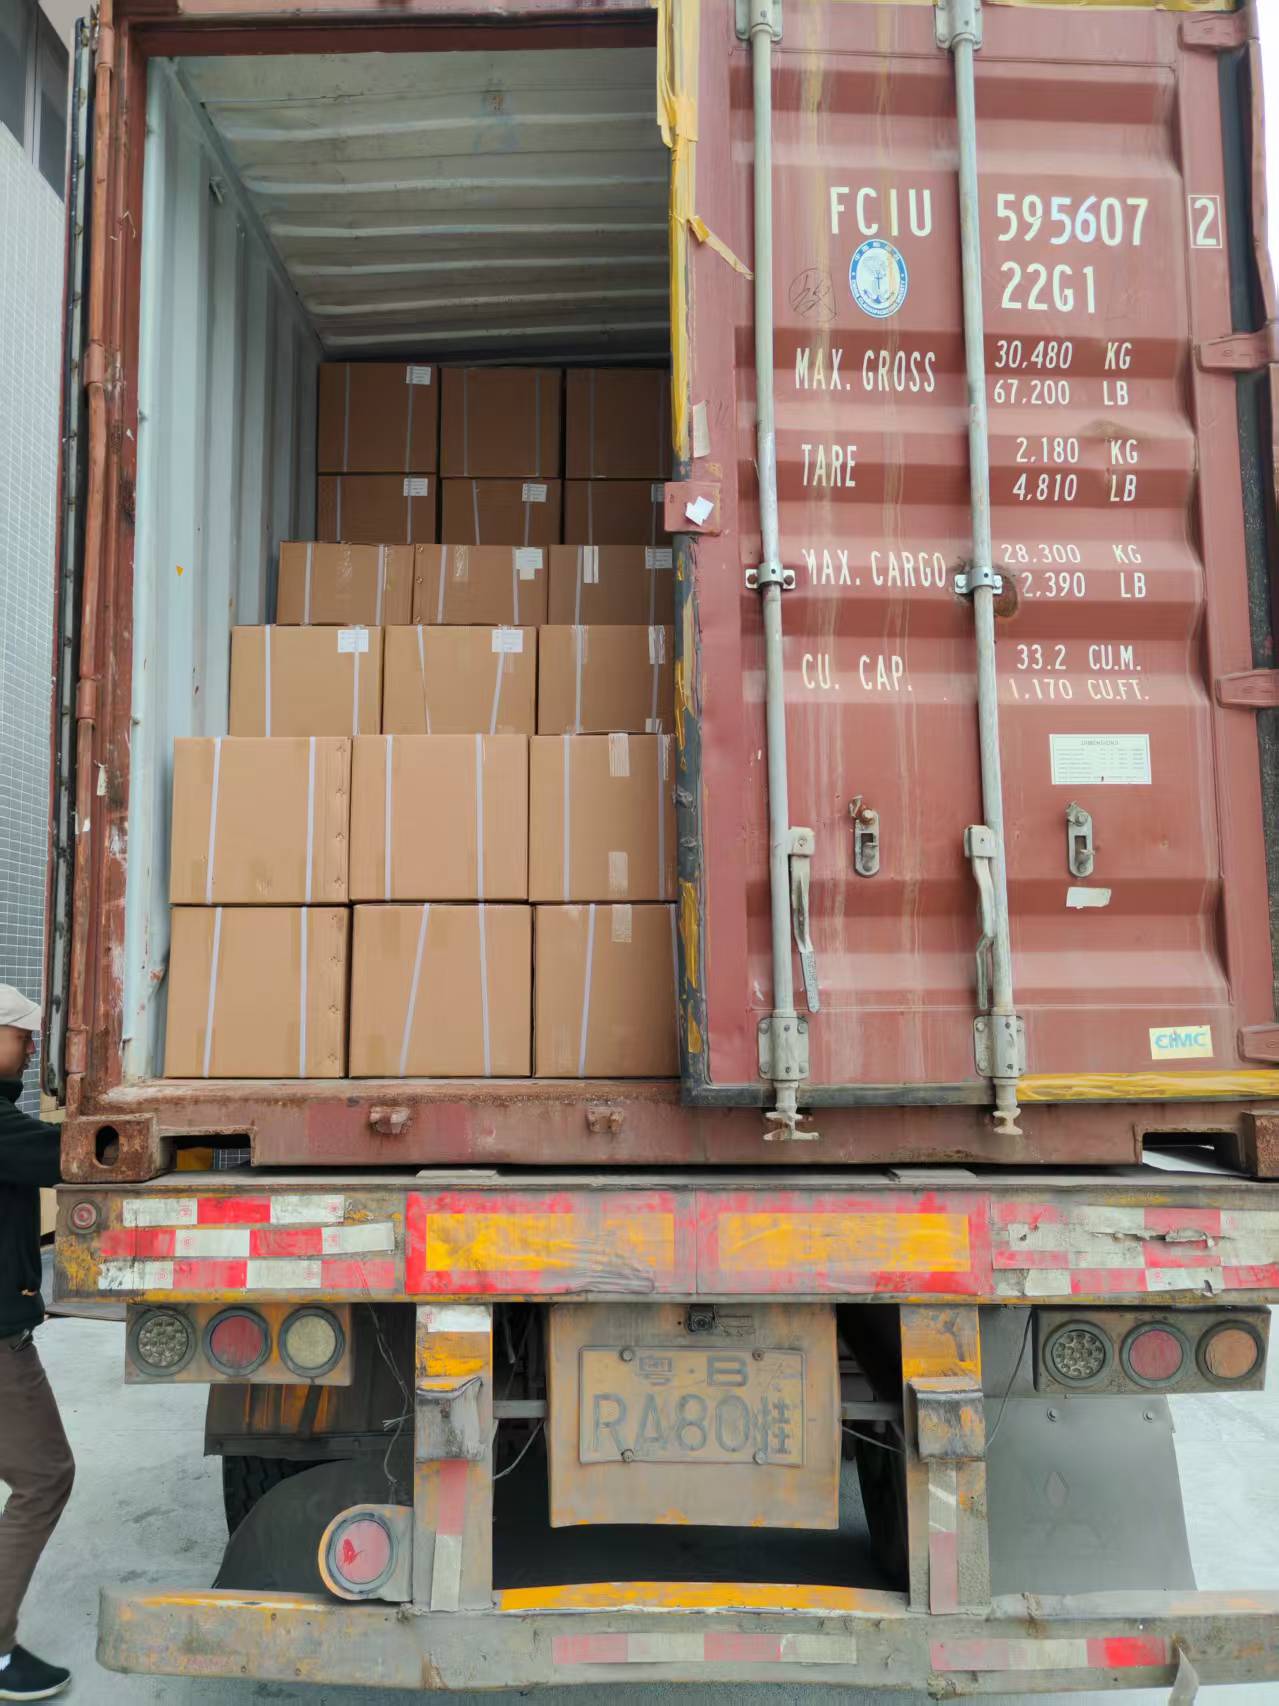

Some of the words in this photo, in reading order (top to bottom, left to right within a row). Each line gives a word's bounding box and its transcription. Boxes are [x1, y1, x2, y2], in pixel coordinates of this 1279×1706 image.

[830, 187, 931, 236] FCIU
[997, 193, 1149, 246] 595607
[1194, 198, 1217, 245] 2
[1001, 261, 1095, 313] 22G1
[795, 348, 850, 390] MAX.
[862, 350, 936, 392] GROSS
[994, 340, 1073, 368] 30,480
[1104, 342, 1132, 370] KG
[994, 379, 1070, 405] 67,200
[1103, 380, 1129, 406] LB
[801, 444, 857, 487] TARE
[1016, 437, 1079, 463] 2,180
[1110, 439, 1138, 464] KG
[1013, 473, 1077, 501] 4,810
[1110, 474, 1137, 502] LB
[802, 549, 861, 585] MAX.
[871, 551, 946, 588] CARGO
[1112, 544, 1142, 564] KG
[1120, 572, 1146, 598] LB
[802, 653, 839, 689] CU.
[860, 655, 912, 691] CAP.
[1016, 644, 1067, 670] 33.2
[1088, 645, 1142, 671] CU.M.
[1087, 679, 1150, 700] CU.FT.
